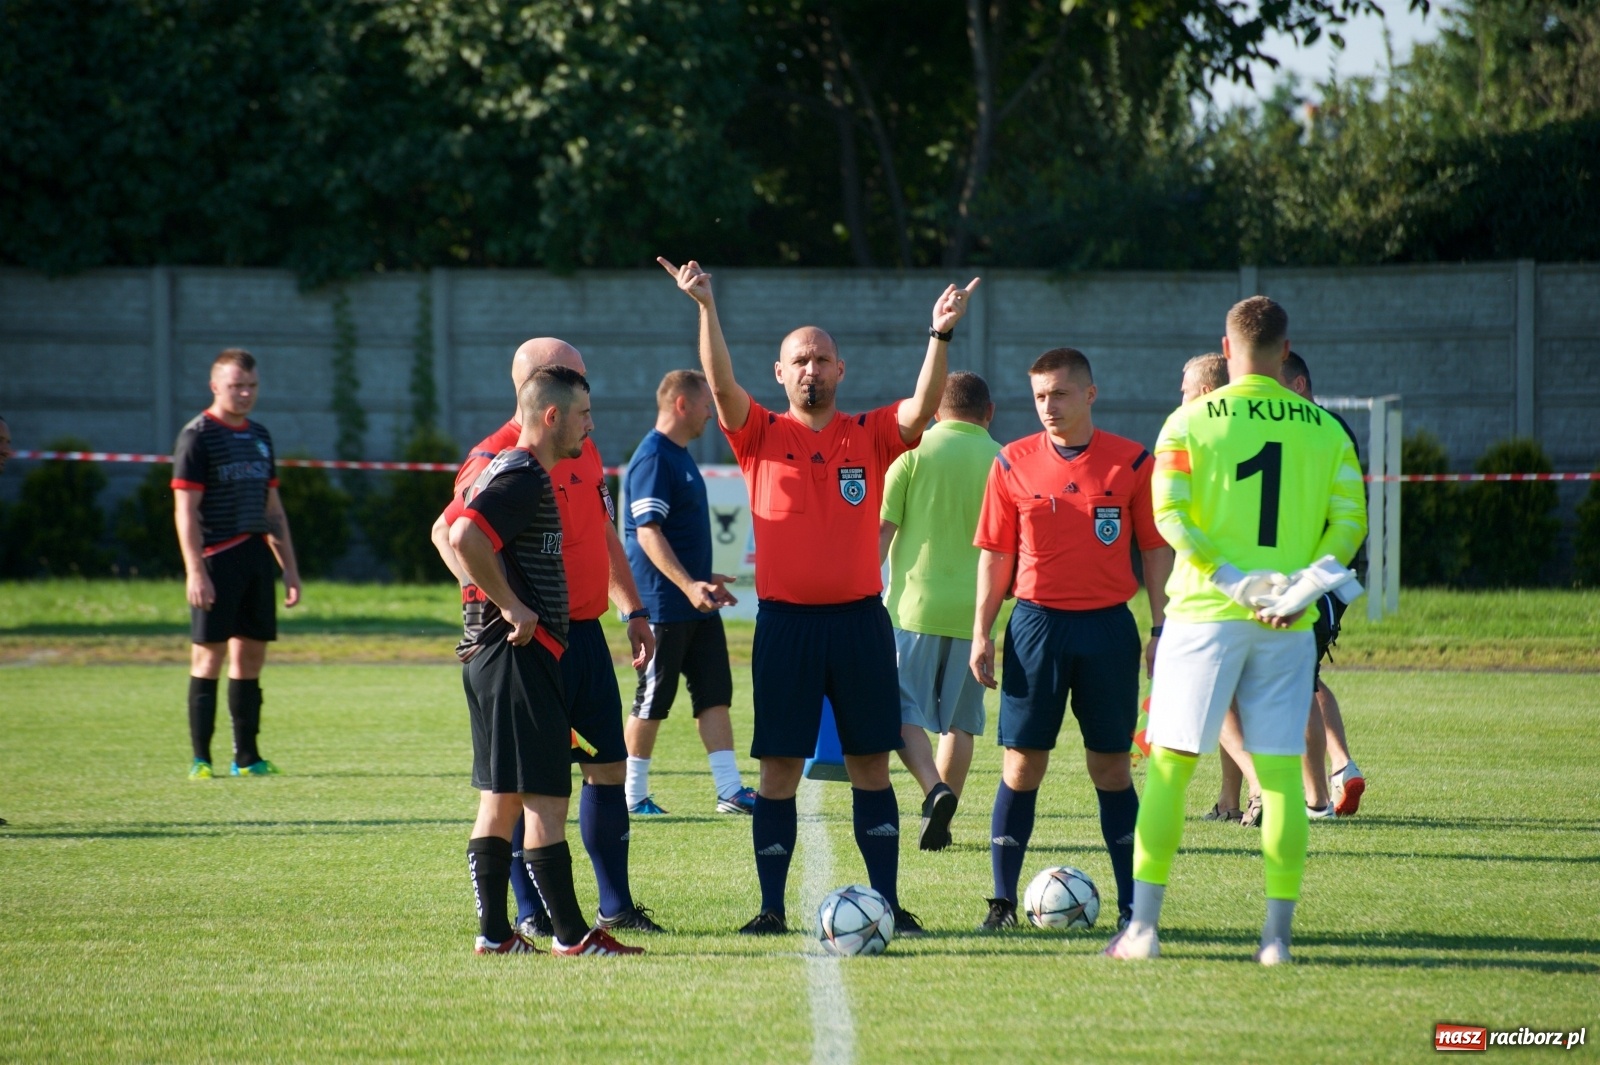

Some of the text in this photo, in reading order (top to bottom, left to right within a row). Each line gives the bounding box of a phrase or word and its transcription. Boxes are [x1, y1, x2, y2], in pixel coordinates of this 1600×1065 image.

[1207, 399, 1322, 426] M. KÜHN
[1235, 441, 1282, 548] 1
